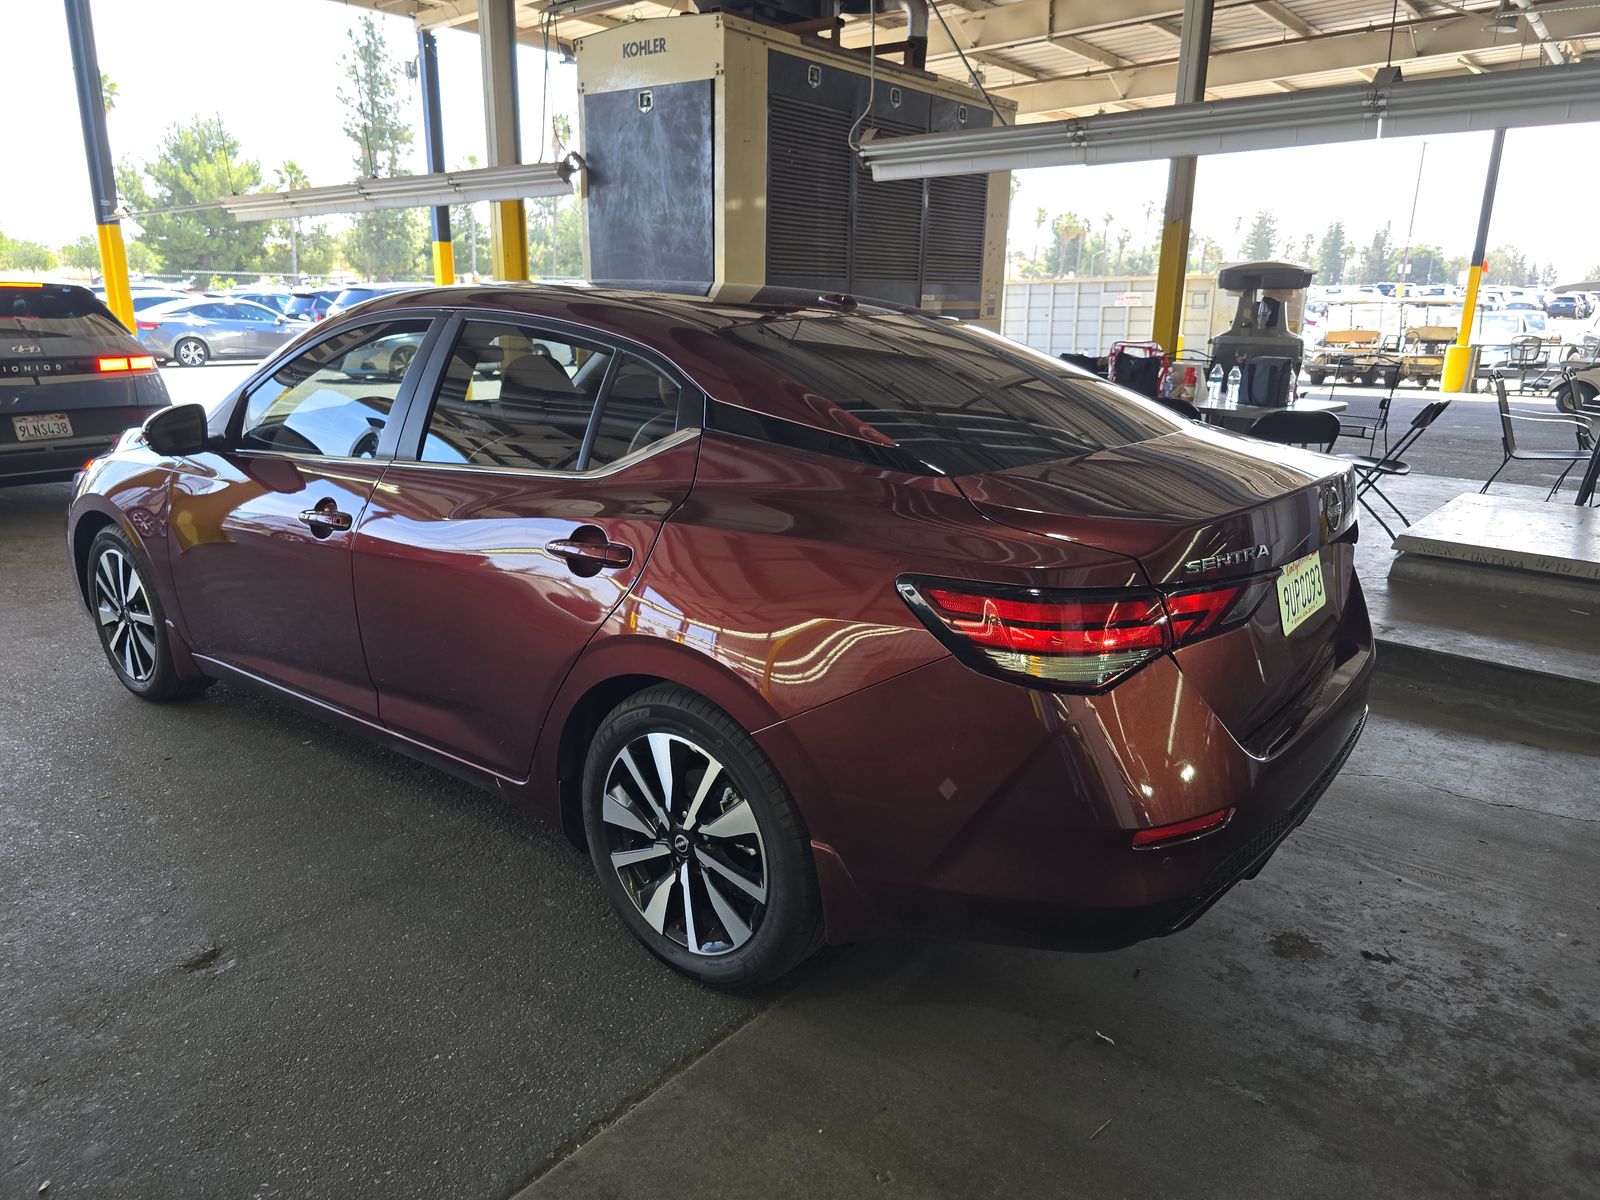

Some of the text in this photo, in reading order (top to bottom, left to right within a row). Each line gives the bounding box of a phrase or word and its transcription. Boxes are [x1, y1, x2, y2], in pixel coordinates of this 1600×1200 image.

[622, 37, 666, 58] KOHLER
[19, 423, 69, 437] 9LNS438
[1184, 544, 1270, 574] SENTRA
[1283, 564, 1323, 623] 9UPC093
